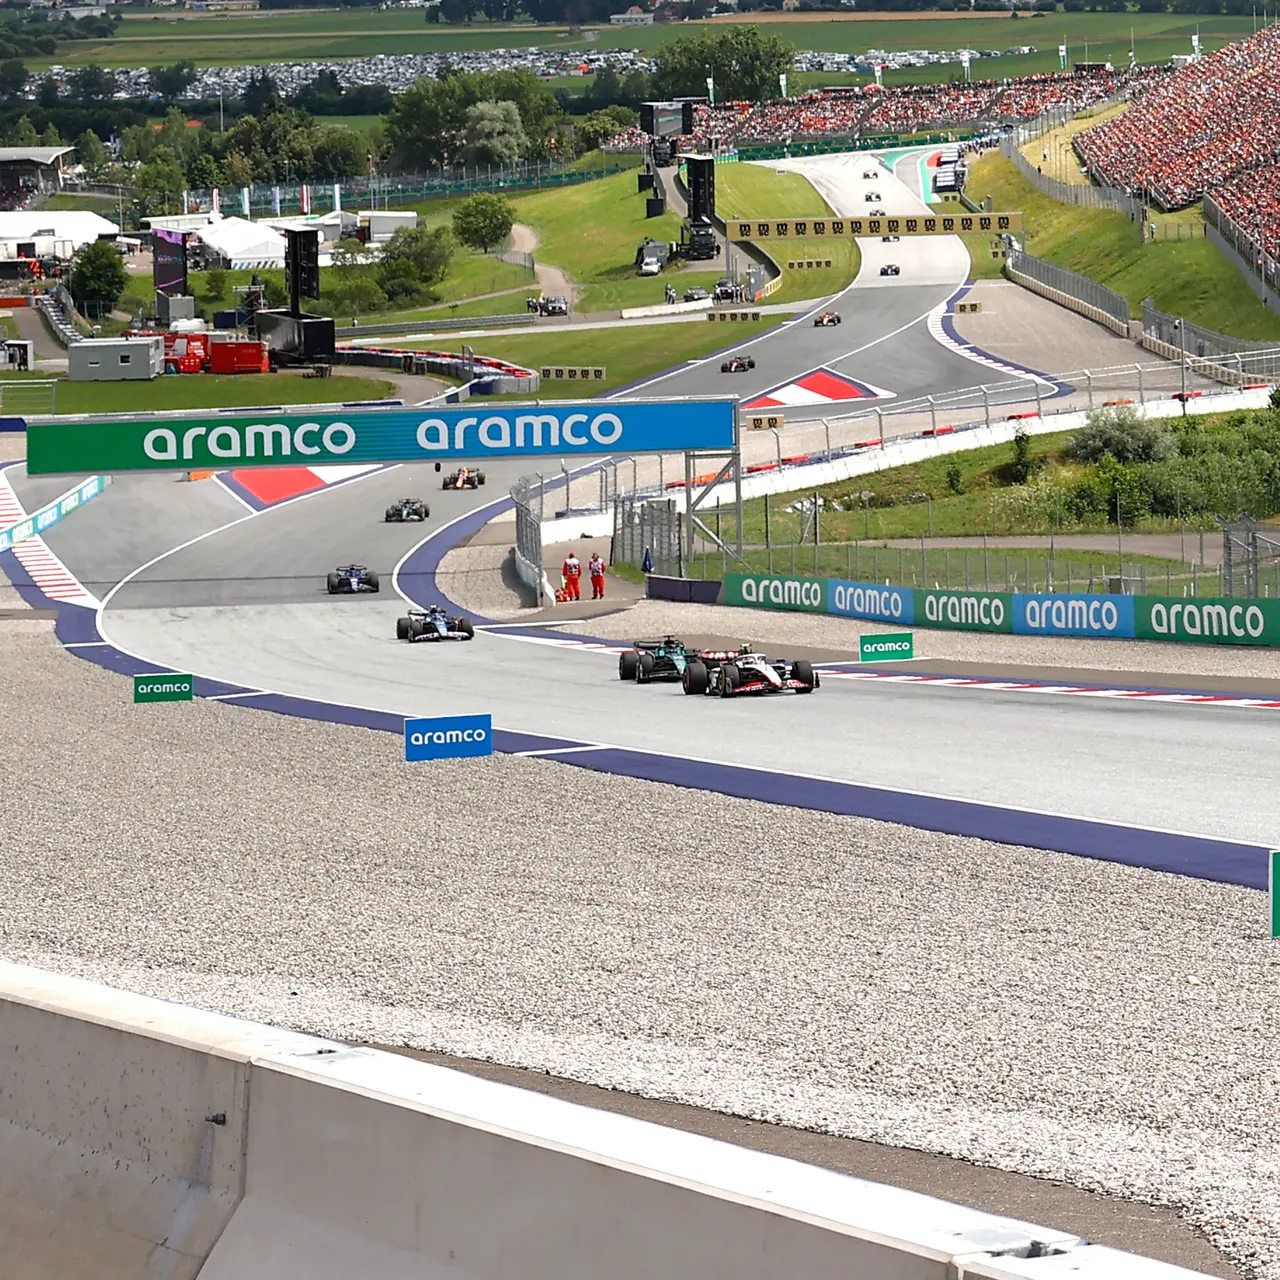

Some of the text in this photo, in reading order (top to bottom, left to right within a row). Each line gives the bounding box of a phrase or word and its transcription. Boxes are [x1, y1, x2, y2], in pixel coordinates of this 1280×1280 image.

[143, 422, 356, 461] aramco
[416, 412, 623, 450] aramco
[742, 579, 820, 607] aramco
[834, 585, 902, 618] aramco
[925, 594, 1004, 626] aramco
[1025, 599, 1118, 631] aramco
[1150, 603, 1265, 638] aramco
[863, 640, 911, 653] aramco
[138, 682, 190, 694] aramco
[410, 727, 486, 745] aramco
